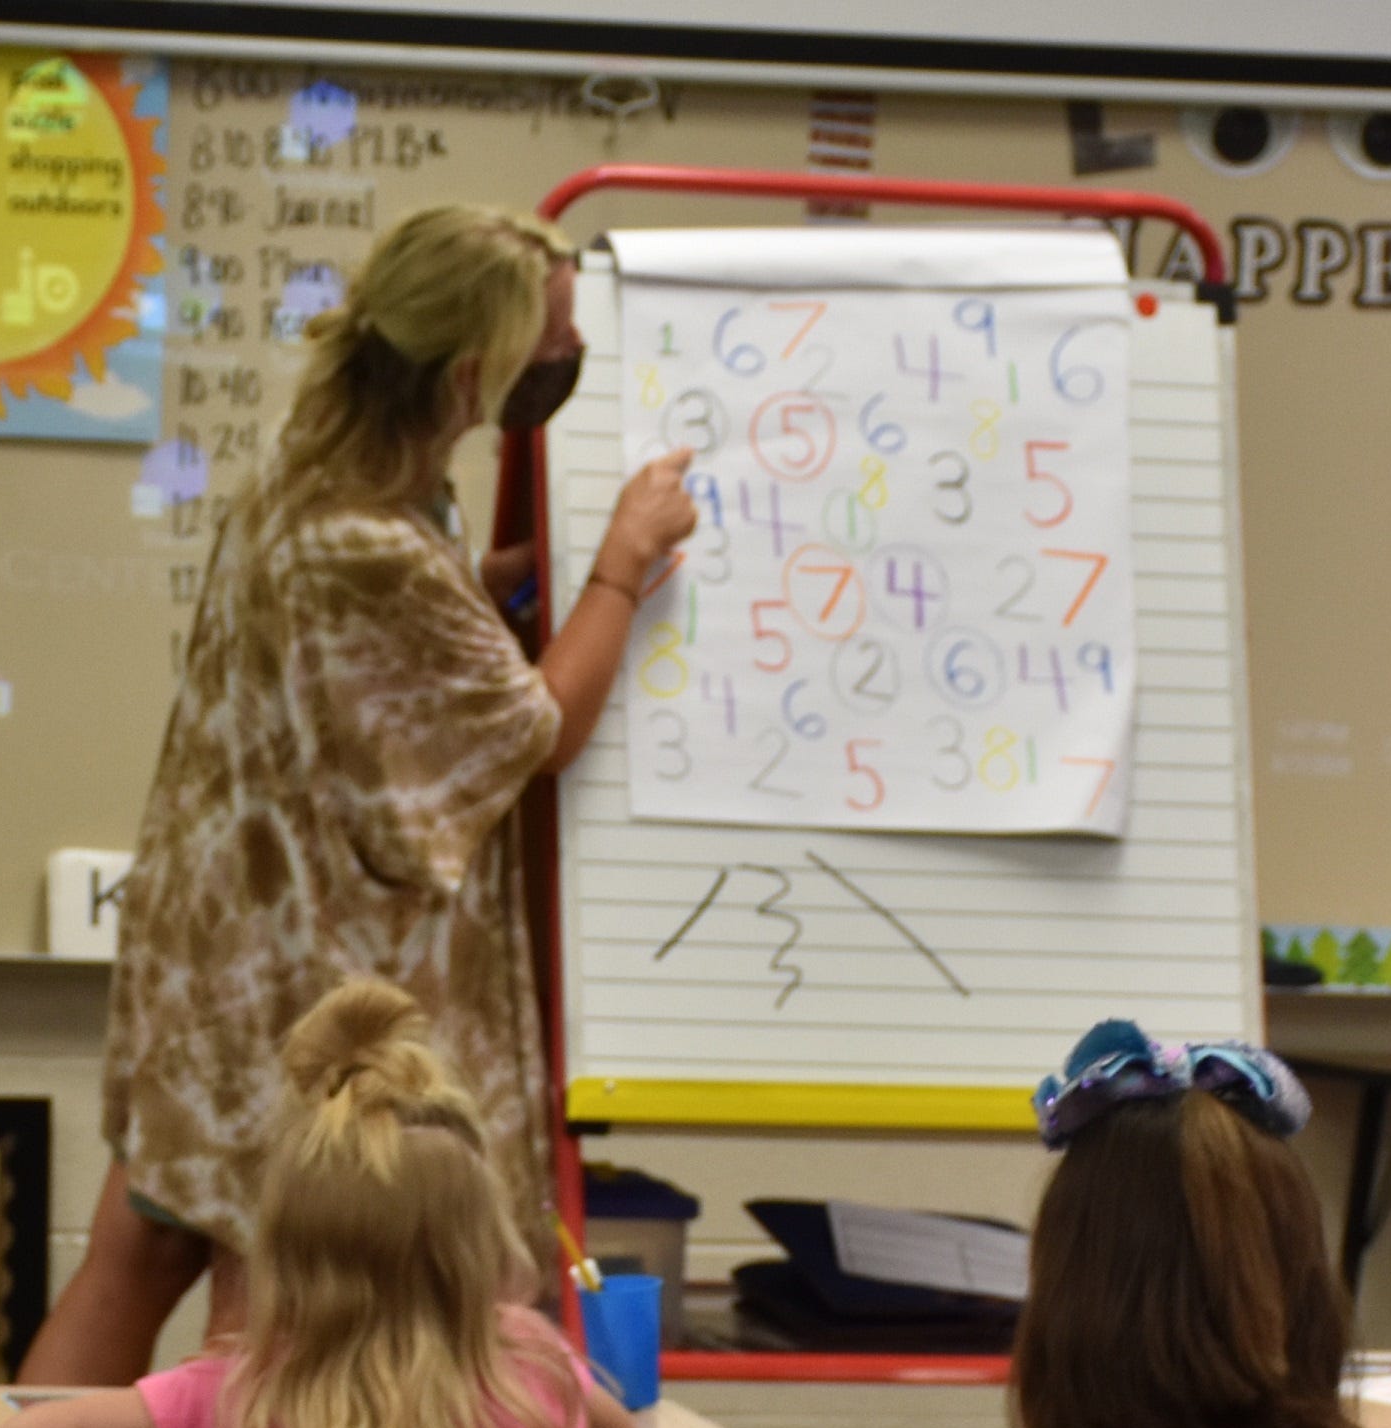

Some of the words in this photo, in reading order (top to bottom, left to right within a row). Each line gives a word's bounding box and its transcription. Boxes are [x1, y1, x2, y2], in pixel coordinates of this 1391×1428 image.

[8, 191, 123, 218] outdoors
[10, 147, 123, 189] shopping
[712, 306, 767, 378] 6
[767, 300, 828, 361] 7
[893, 333, 966, 403] 4
[952, 298, 998, 358] 9
[1049, 318, 1106, 404] 6
[779, 403, 820, 470] 5
[859, 393, 908, 457] 6
[684, 472, 724, 528] 9
[738, 477, 806, 558] 4
[857, 454, 890, 511] 8
[928, 450, 972, 527] 3
[1023, 439, 1075, 530] 5
[796, 564, 855, 625] 7
[885, 557, 943, 630] 4
[992, 554, 1045, 625] 2
[1039, 546, 1110, 628] 7
[636, 619, 691, 699] 8
[750, 598, 794, 674] 5
[850, 640, 895, 703] 2
[943, 639, 986, 700] 6
[1016, 642, 1077, 713] 4
[1076, 641, 1116, 695] 9
[647, 708, 694, 784] 3
[781, 678, 828, 741] 6
[748, 727, 807, 799] 2
[845, 737, 886, 813] 5
[925, 713, 973, 793] 3
[976, 724, 1022, 793] 8
[1059, 755, 1117, 819] 7
